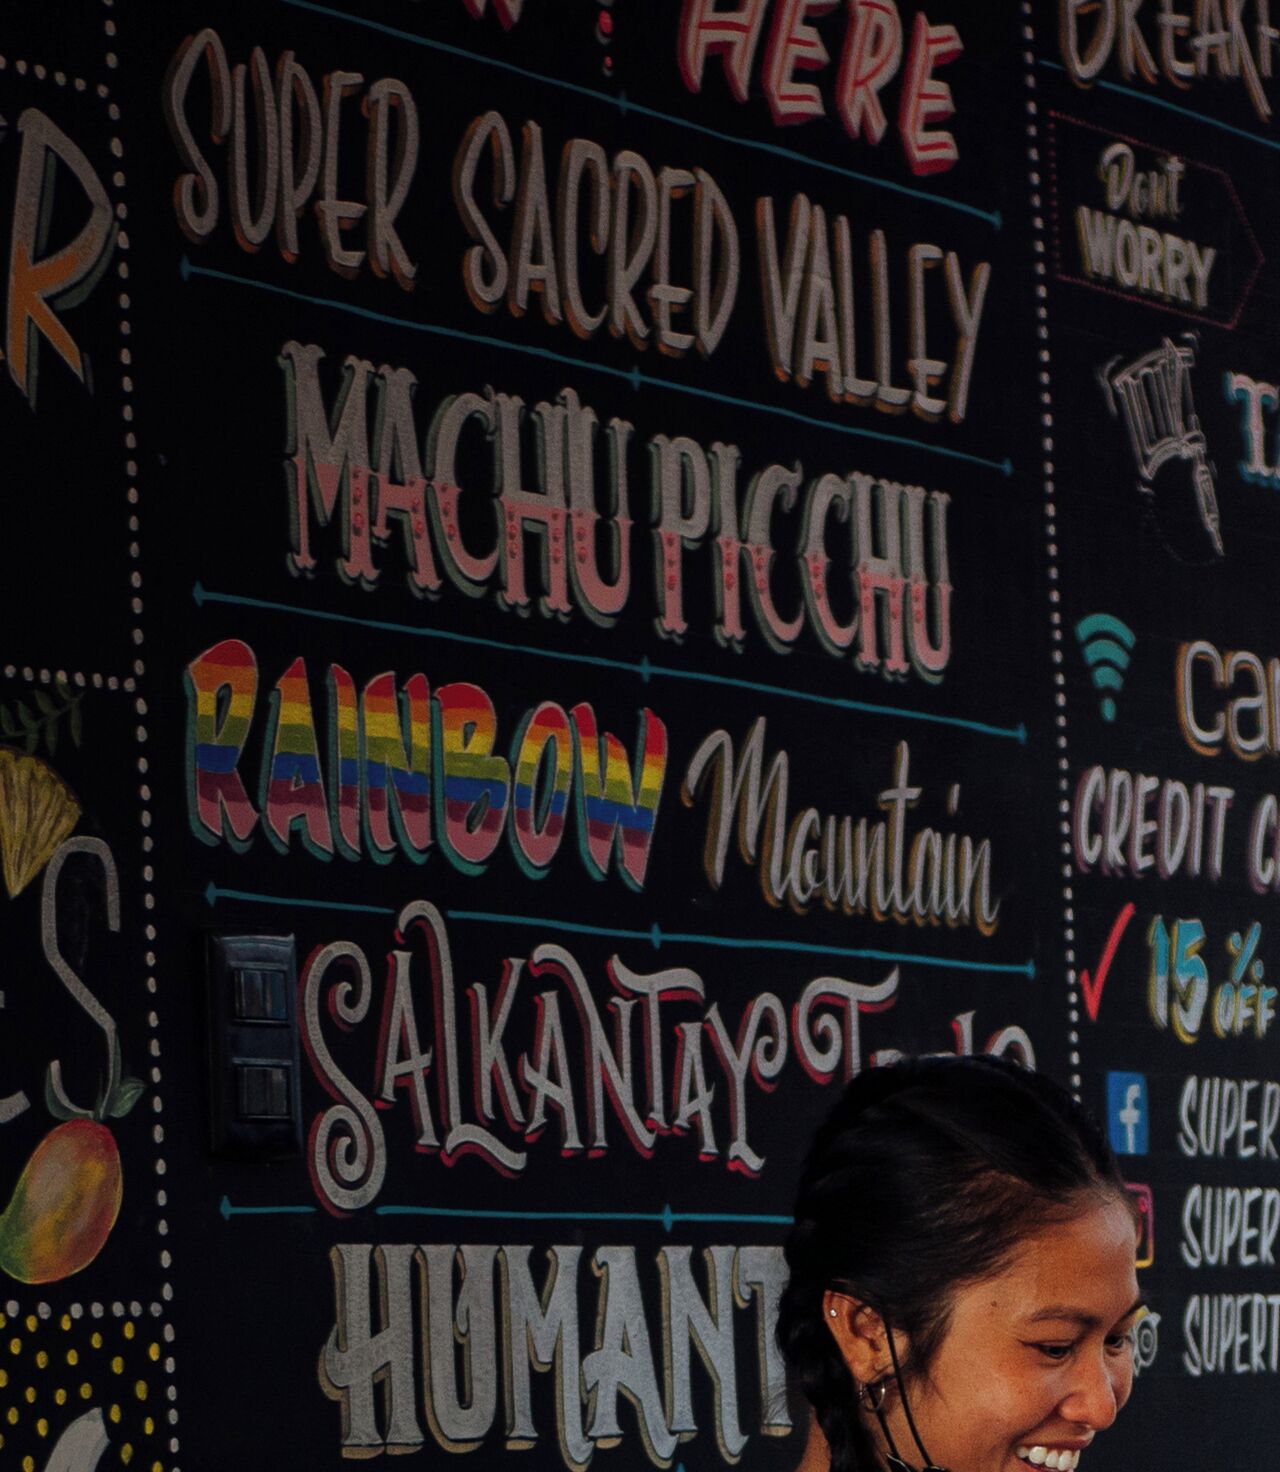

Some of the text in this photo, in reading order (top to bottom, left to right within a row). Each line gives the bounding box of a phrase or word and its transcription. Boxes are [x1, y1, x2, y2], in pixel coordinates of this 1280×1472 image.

[163, 27, 991, 424] SUPER SACRED VALLEY
[678, 0, 962, 176] HERE
[1076, 205, 1217, 310] WORRY
[279, 339, 953, 682] MACHU PICCHU
[184, 638, 1002, 936] RAINBOW Mountain
[1074, 766, 1235, 878] CREDIT
[299, 899, 789, 1217] SALKANTAY
